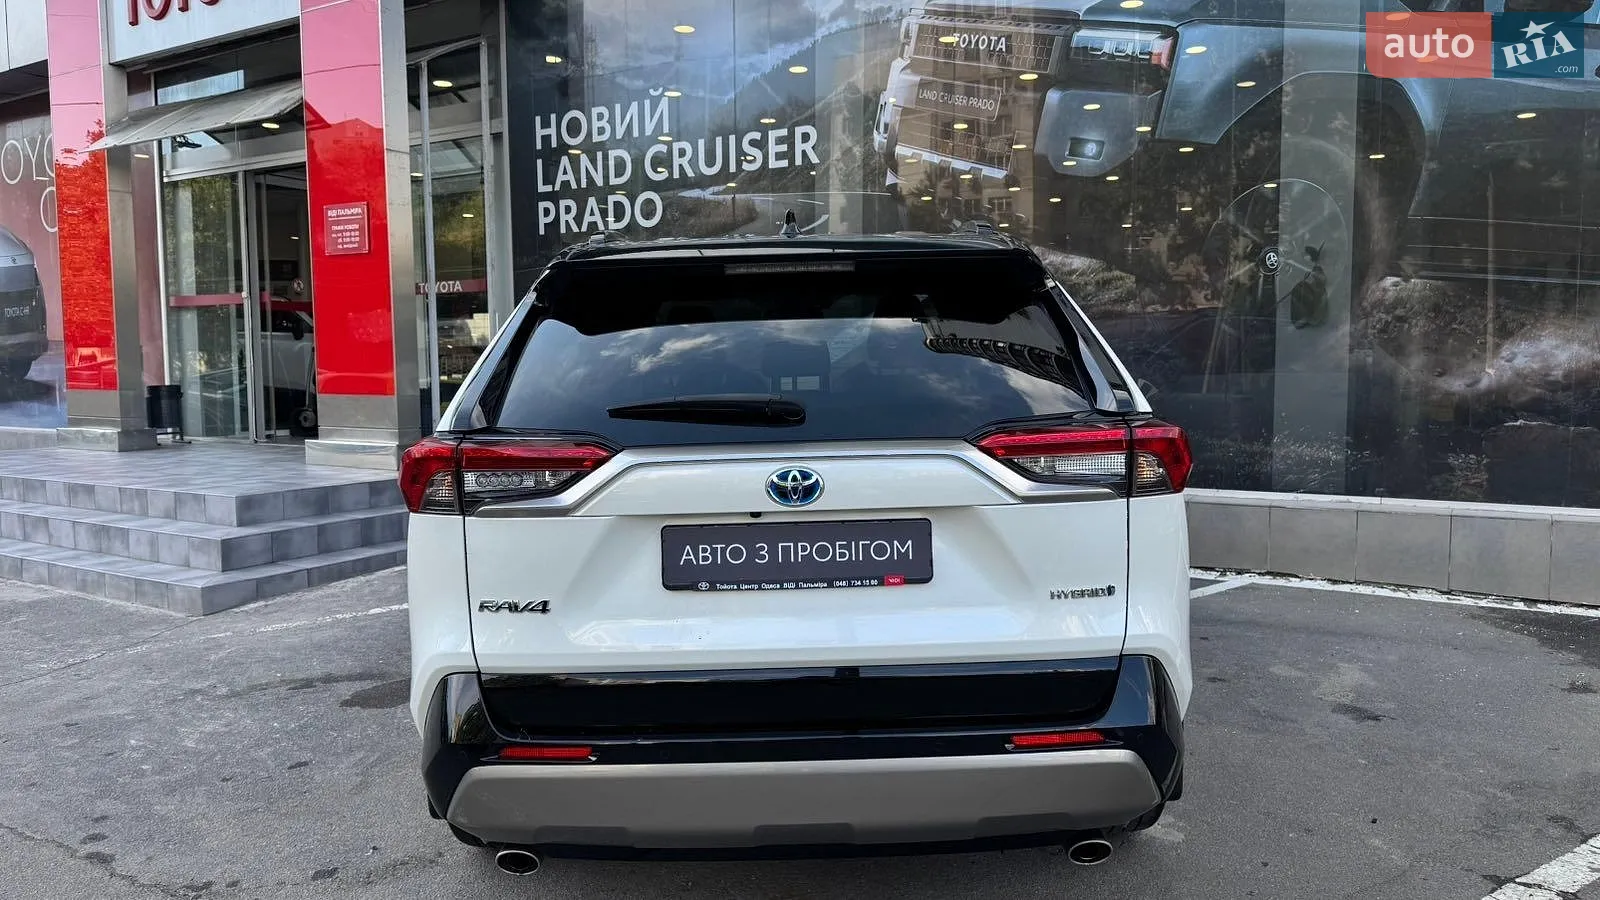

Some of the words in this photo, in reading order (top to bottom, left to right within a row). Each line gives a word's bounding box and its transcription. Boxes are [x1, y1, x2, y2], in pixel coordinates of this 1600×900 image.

[953, 33, 1006, 52] TOYOTA
[919, 88, 937, 101] LAND
[968, 96, 995, 111] PRADO
[535, 87, 670, 150] НОВИЙ
[536, 148, 632, 193] LAND
[644, 124, 821, 182] CRUISER
[538, 190, 664, 236] PRADO
[680, 543, 747, 566] АВТО
[778, 539, 913, 563] ПРОБІГОМ
[761, 582, 780, 590] Одеса
[799, 581, 827, 589] Пальміра
[1049, 587, 1107, 600] HYBRID
[478, 599, 552, 614] RAV4
